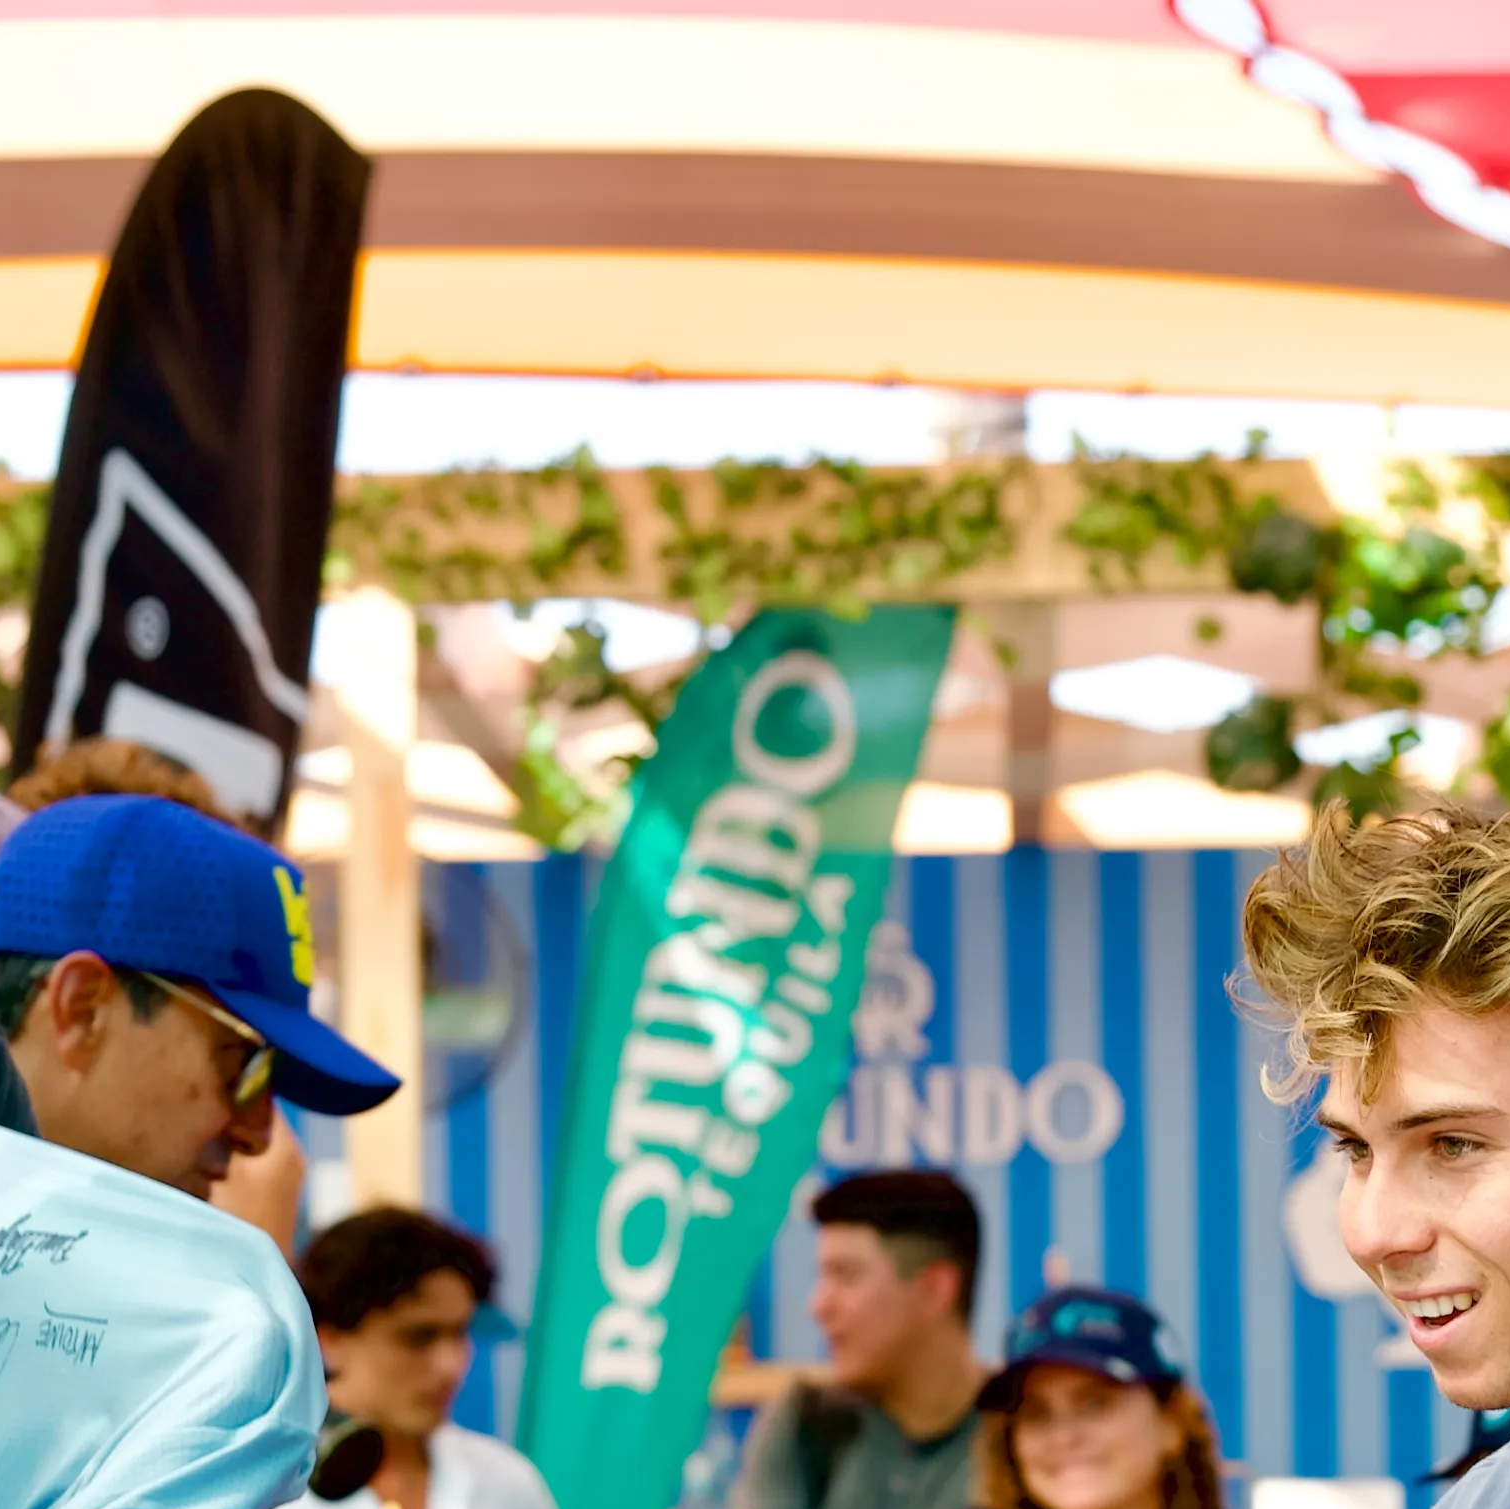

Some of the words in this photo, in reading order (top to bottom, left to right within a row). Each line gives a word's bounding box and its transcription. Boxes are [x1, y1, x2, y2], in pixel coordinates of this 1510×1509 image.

[580, 650, 856, 1395] ROTUNDO
[688, 873, 855, 1220] TEQUILA
[819, 1060, 1125, 1166] UNDO
